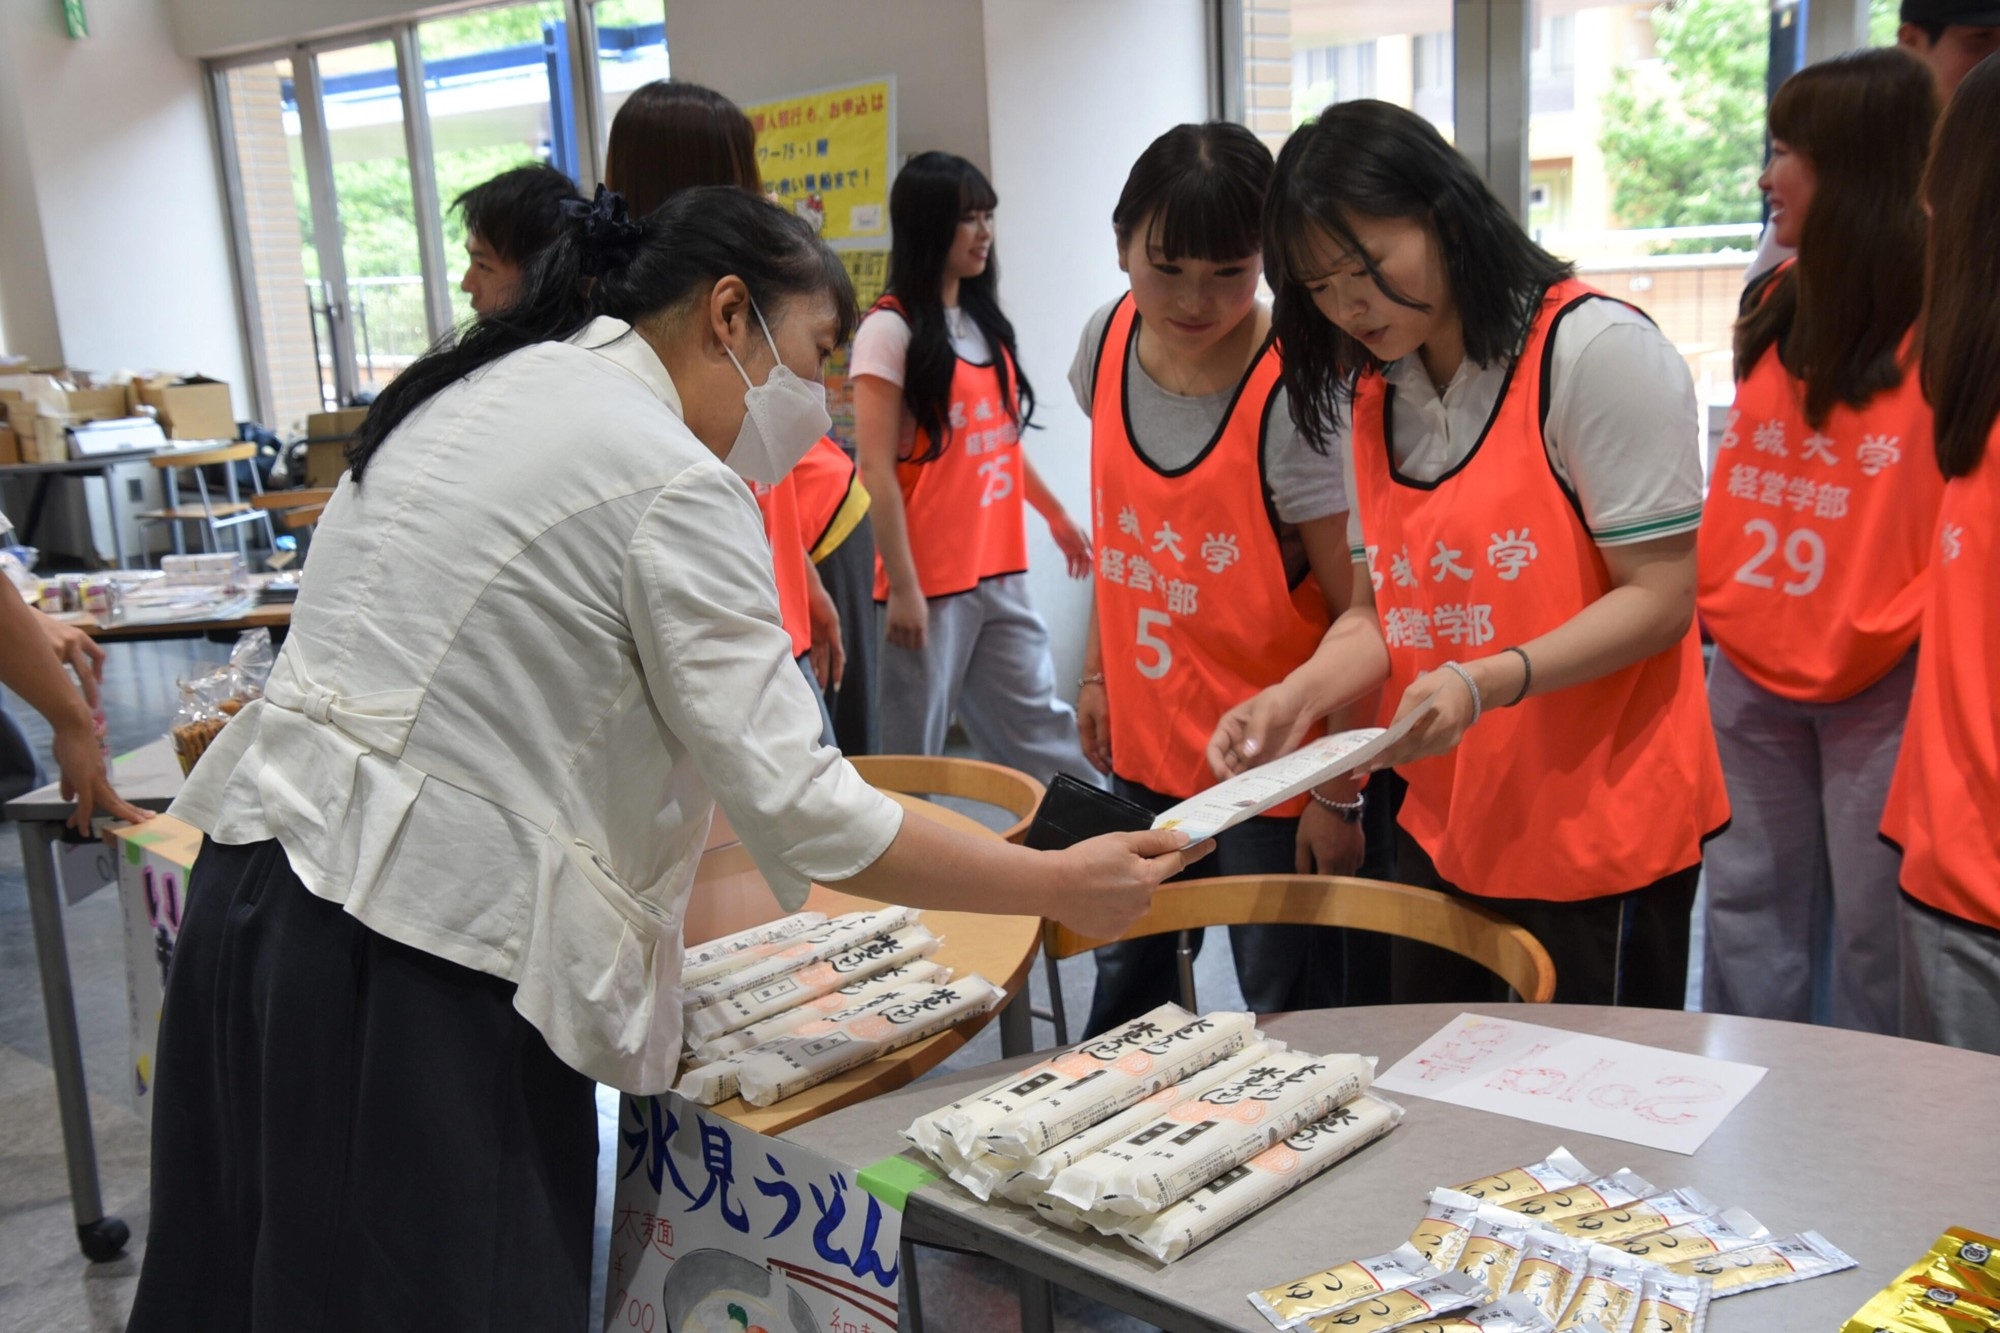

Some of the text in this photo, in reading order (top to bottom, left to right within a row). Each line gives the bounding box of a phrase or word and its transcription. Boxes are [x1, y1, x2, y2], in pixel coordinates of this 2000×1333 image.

[977, 455, 1014, 508] 25
[1726, 463, 1850, 520] 経営学部
[1101, 546, 1199, 617] 経営部
[1734, 518, 1826, 596] 29
[1136, 607, 1173, 680] 5
[622, 1095, 899, 1288] 氷見うどん
[614, 1202, 675, 1260] 太麺
[1285, 1271, 1344, 1300] つゆ
[1332, 1299, 1391, 1325] つゆ
